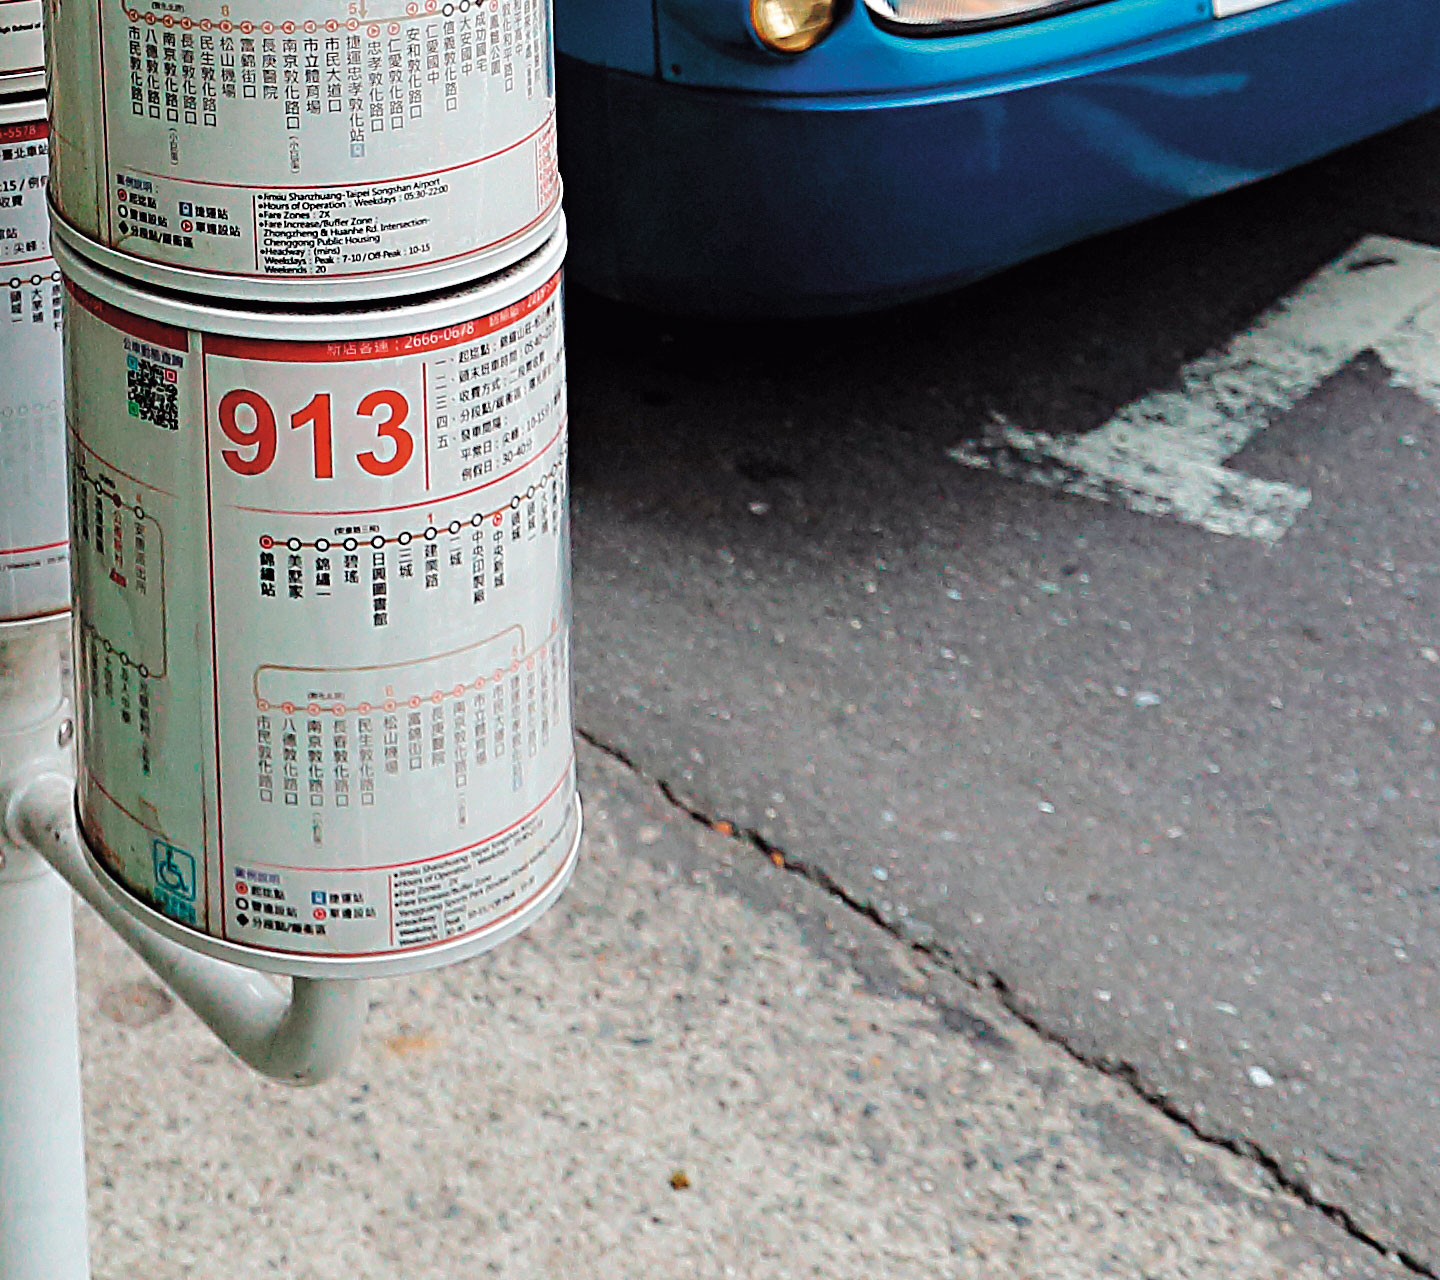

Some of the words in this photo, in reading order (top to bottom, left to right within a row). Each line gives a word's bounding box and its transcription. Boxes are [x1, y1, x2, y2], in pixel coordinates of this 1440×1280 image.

[325, 37, 342, 112] 市民大道口
[218, 388, 415, 479] 913
